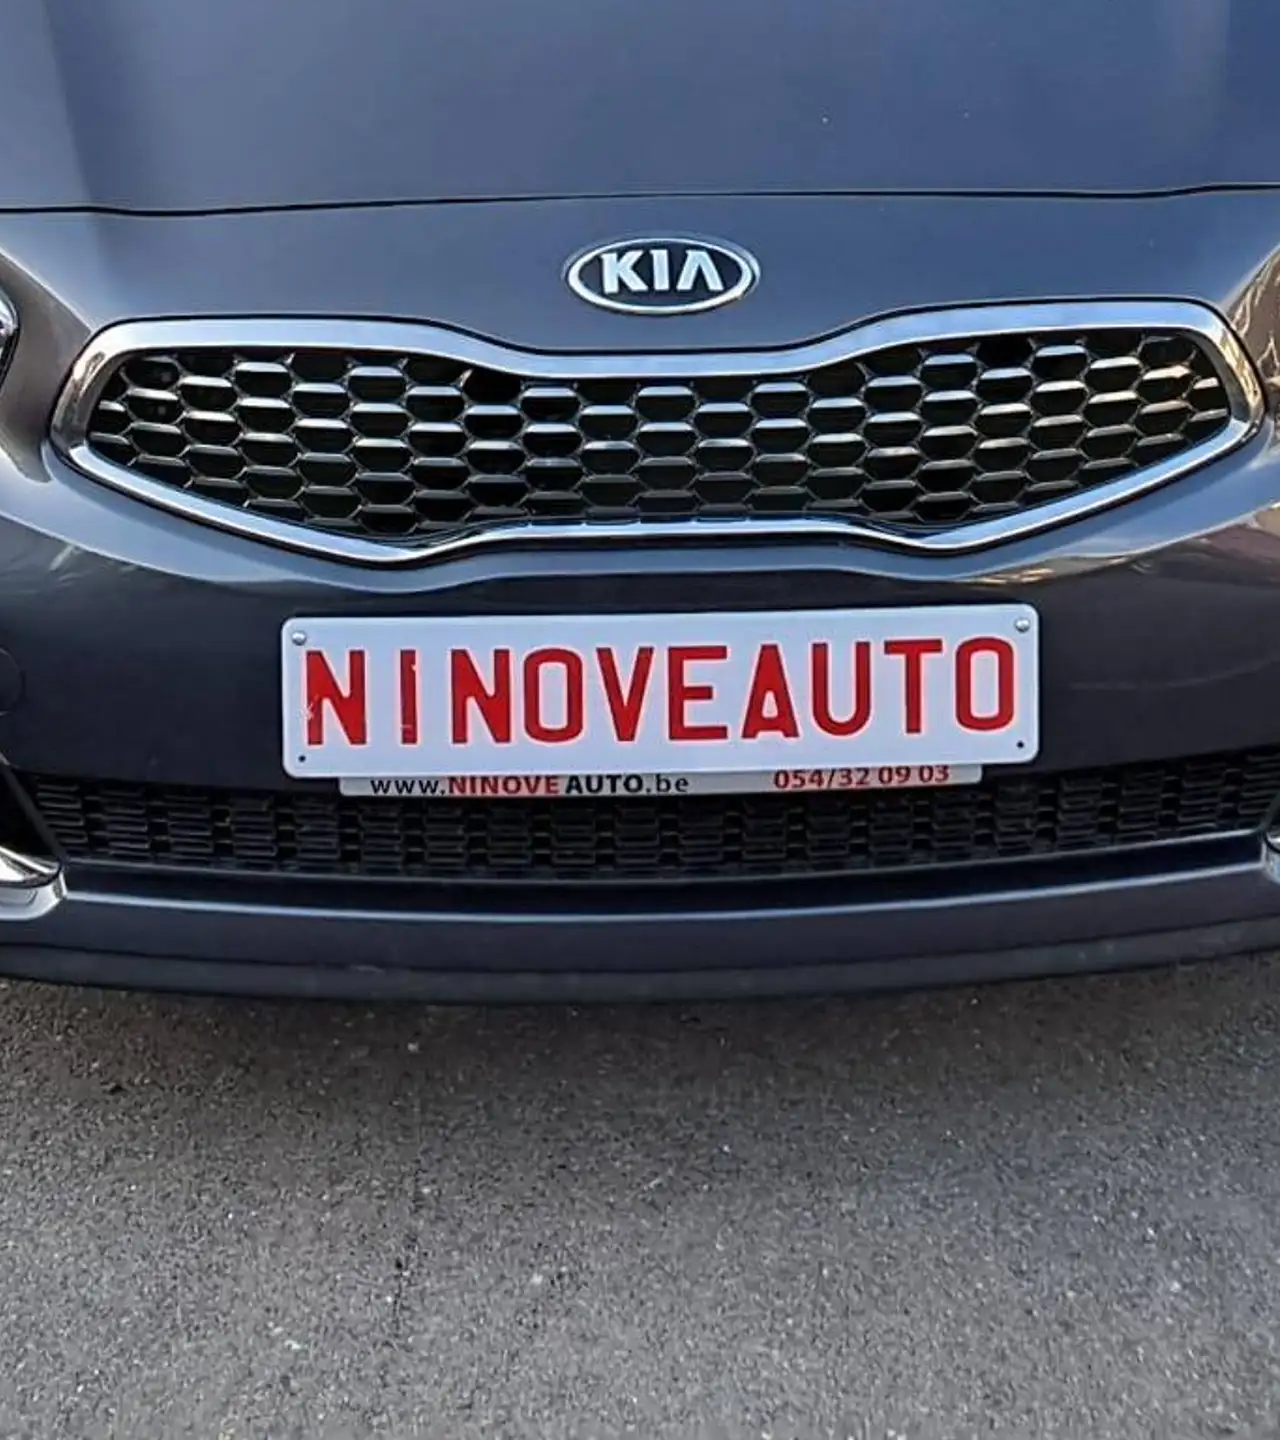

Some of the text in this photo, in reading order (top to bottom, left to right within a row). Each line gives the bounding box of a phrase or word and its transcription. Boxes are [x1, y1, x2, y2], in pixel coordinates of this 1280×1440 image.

[599, 248, 724, 295] KIA
[304, 638, 1016, 746] NINOVEAUTO
[773, 764, 950, 790] 054/32 09 03
